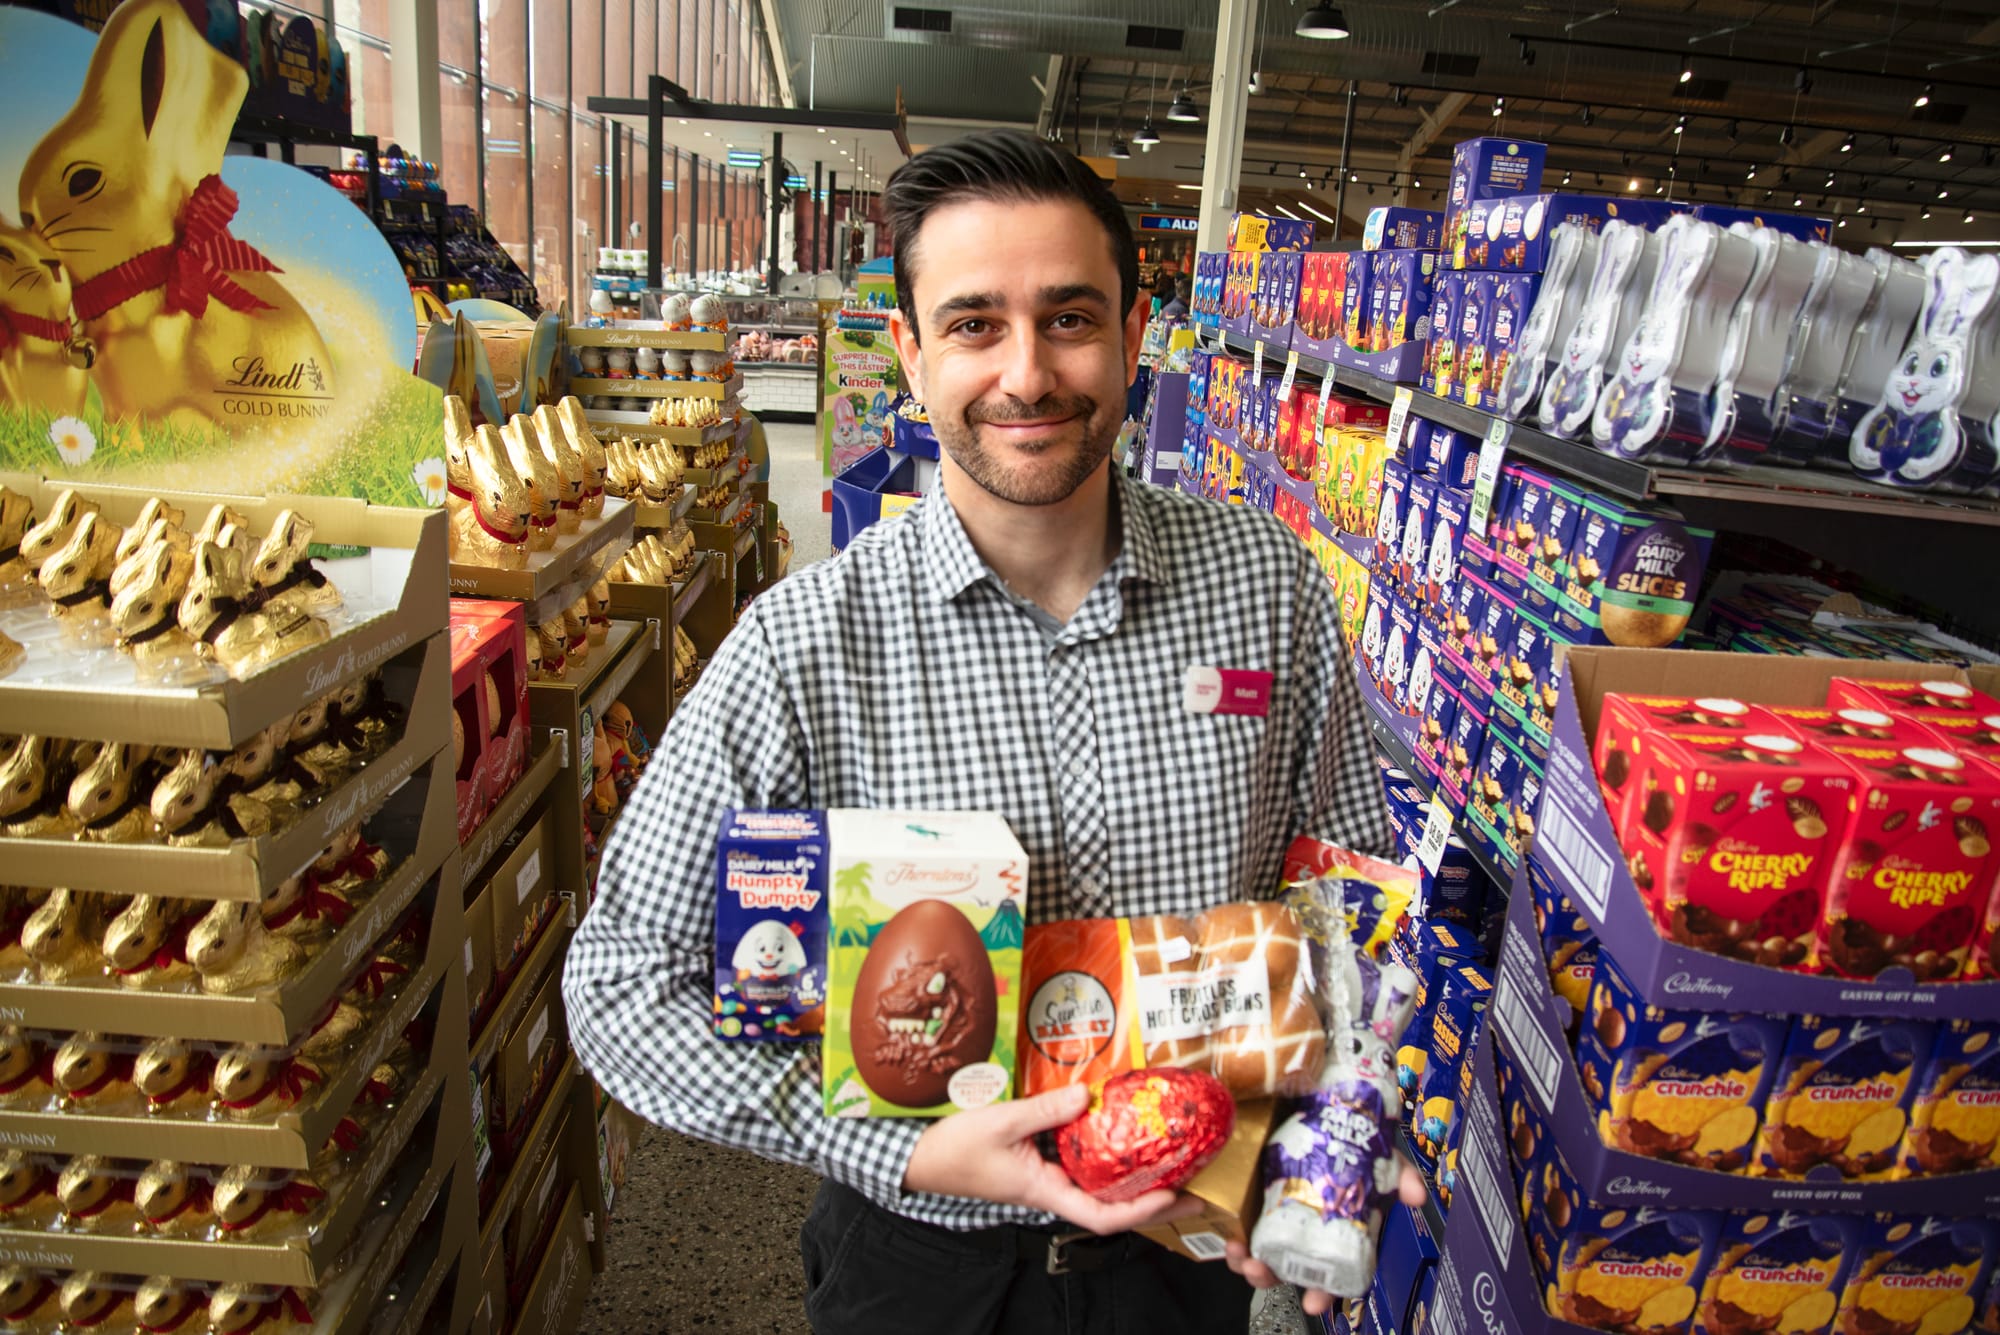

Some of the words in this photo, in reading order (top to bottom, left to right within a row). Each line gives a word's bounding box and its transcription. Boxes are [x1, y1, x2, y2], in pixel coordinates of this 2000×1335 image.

[1172, 219, 1198, 230] ALD
[833, 353, 869, 362] SURPRISE
[871, 354, 892, 365] THEM
[840, 362, 857, 370] THIS
[858, 363, 886, 372] EASTER
[225, 356, 306, 391] Lindt
[839, 374, 883, 388] Kinder
[223, 399, 274, 416] GOLD
[278, 401, 331, 418] BUNNY
[1636, 544, 1685, 563] DAIRY
[1635, 559, 1676, 577] MILK
[302, 655, 347, 697] Lindt
[1530, 708, 1554, 735] SLICE
[1710, 851, 1813, 877] CHERRY
[730, 874, 805, 892] Humpty
[884, 861, 978, 890] Thorntons
[1728, 870, 1788, 894] RIPE
[1873, 868, 1974, 894] CHERRY
[743, 891, 817, 909] Dumpty
[1889, 887, 1949, 910] RIPE
[1664, 972, 1734, 1000] Cadbury
[1840, 990, 1884, 1001] EASTER
[1884, 991, 1911, 1001] GIFT
[1912, 992, 1936, 1003] BOX
[1036, 1019, 1110, 1039] BAKRY
[1657, 1080, 1746, 1098] crunchie
[1809, 1083, 1896, 1101] crunchie
[1319, 1106, 1379, 1138] DAIRY
[1321, 1119, 1371, 1152] MILK
[1606, 1176, 1672, 1198] Cadbury
[1772, 1189, 1813, 1200] EASTER
[1814, 1190, 1838, 1200] GIFT
[1840, 1191, 1863, 1201] BOX
[1599, 1261, 1685, 1279] crunchie
[1741, 1267, 1825, 1284] crunchie
[1882, 1274, 1967, 1290] crunchie
